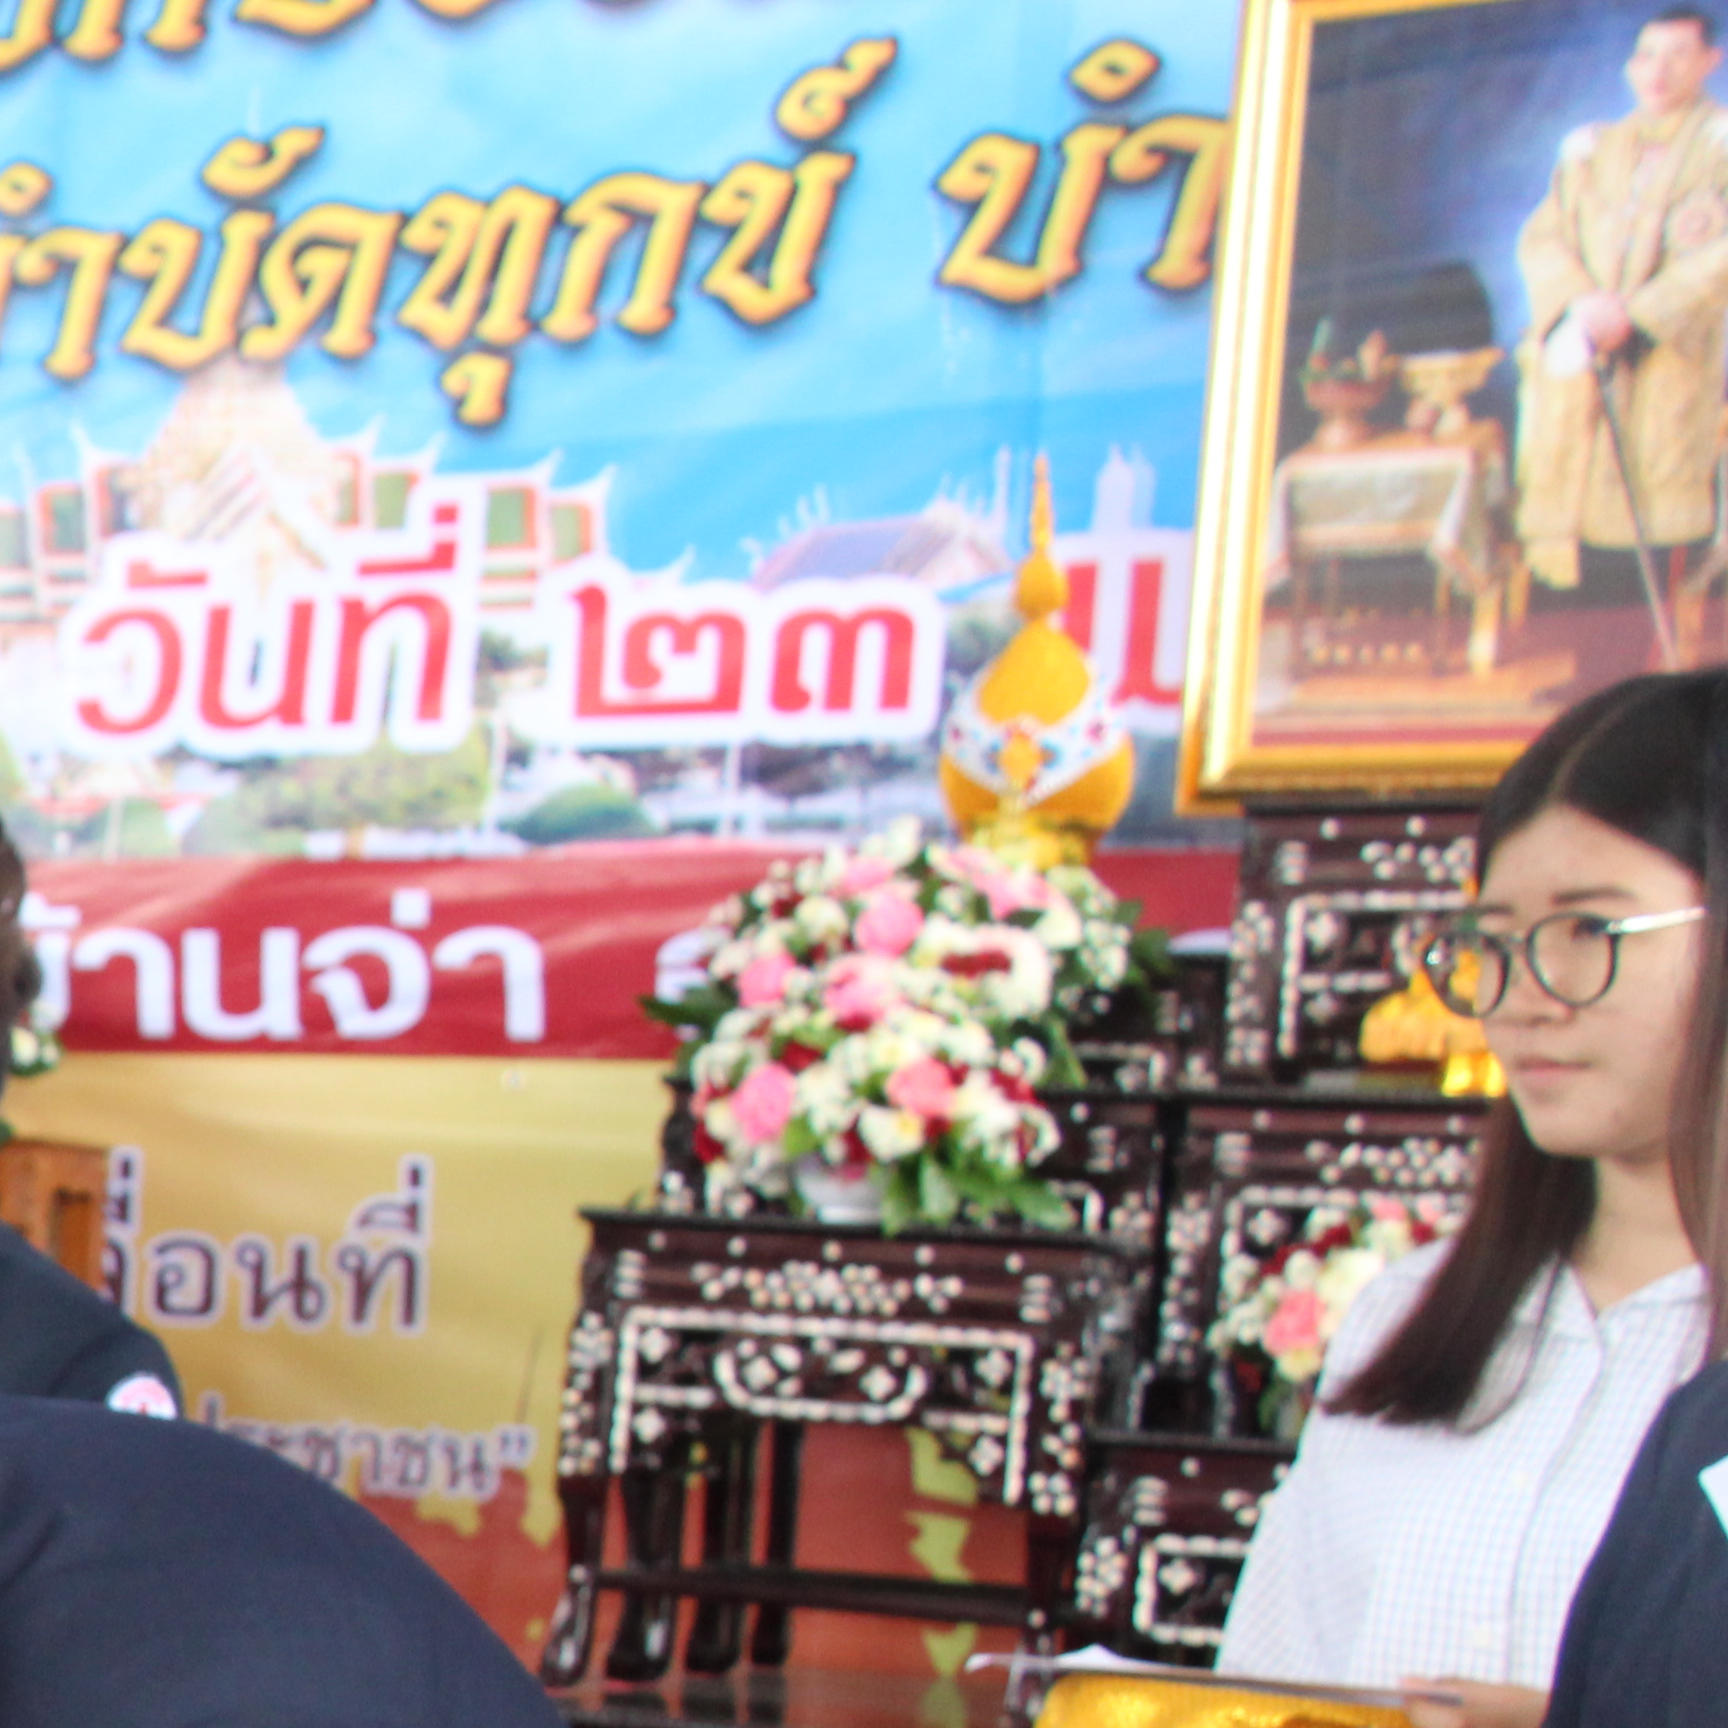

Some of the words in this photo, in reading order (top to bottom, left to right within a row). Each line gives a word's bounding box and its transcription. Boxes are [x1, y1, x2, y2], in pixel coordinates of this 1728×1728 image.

[74, 503, 458, 738] วันที่
[570, 582, 916, 722] ๒๓
